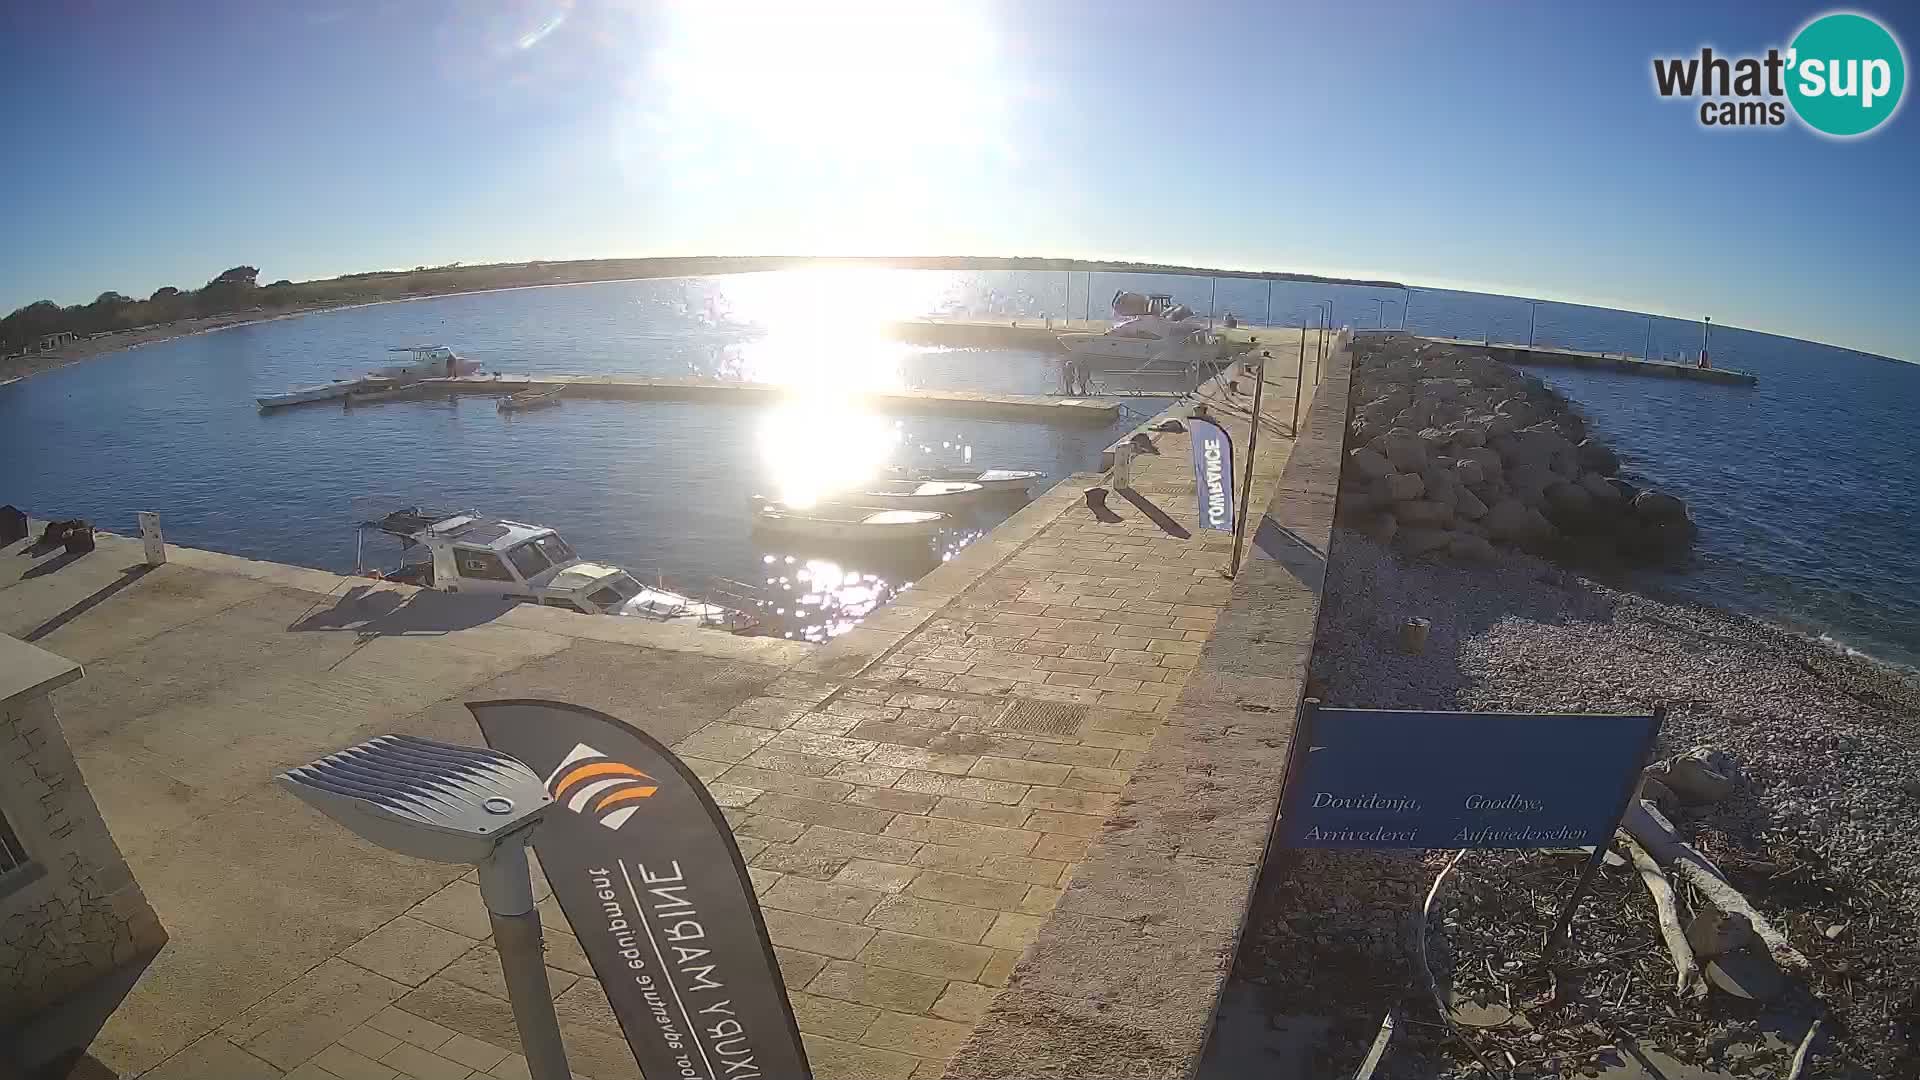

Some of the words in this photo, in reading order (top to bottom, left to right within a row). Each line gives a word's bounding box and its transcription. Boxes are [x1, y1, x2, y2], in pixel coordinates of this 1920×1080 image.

[1312, 792, 1422, 813] Dovidenja,
[1465, 794, 1544, 813] Goodbye,
[1453, 825, 1587, 844] Aufwiedersehen
